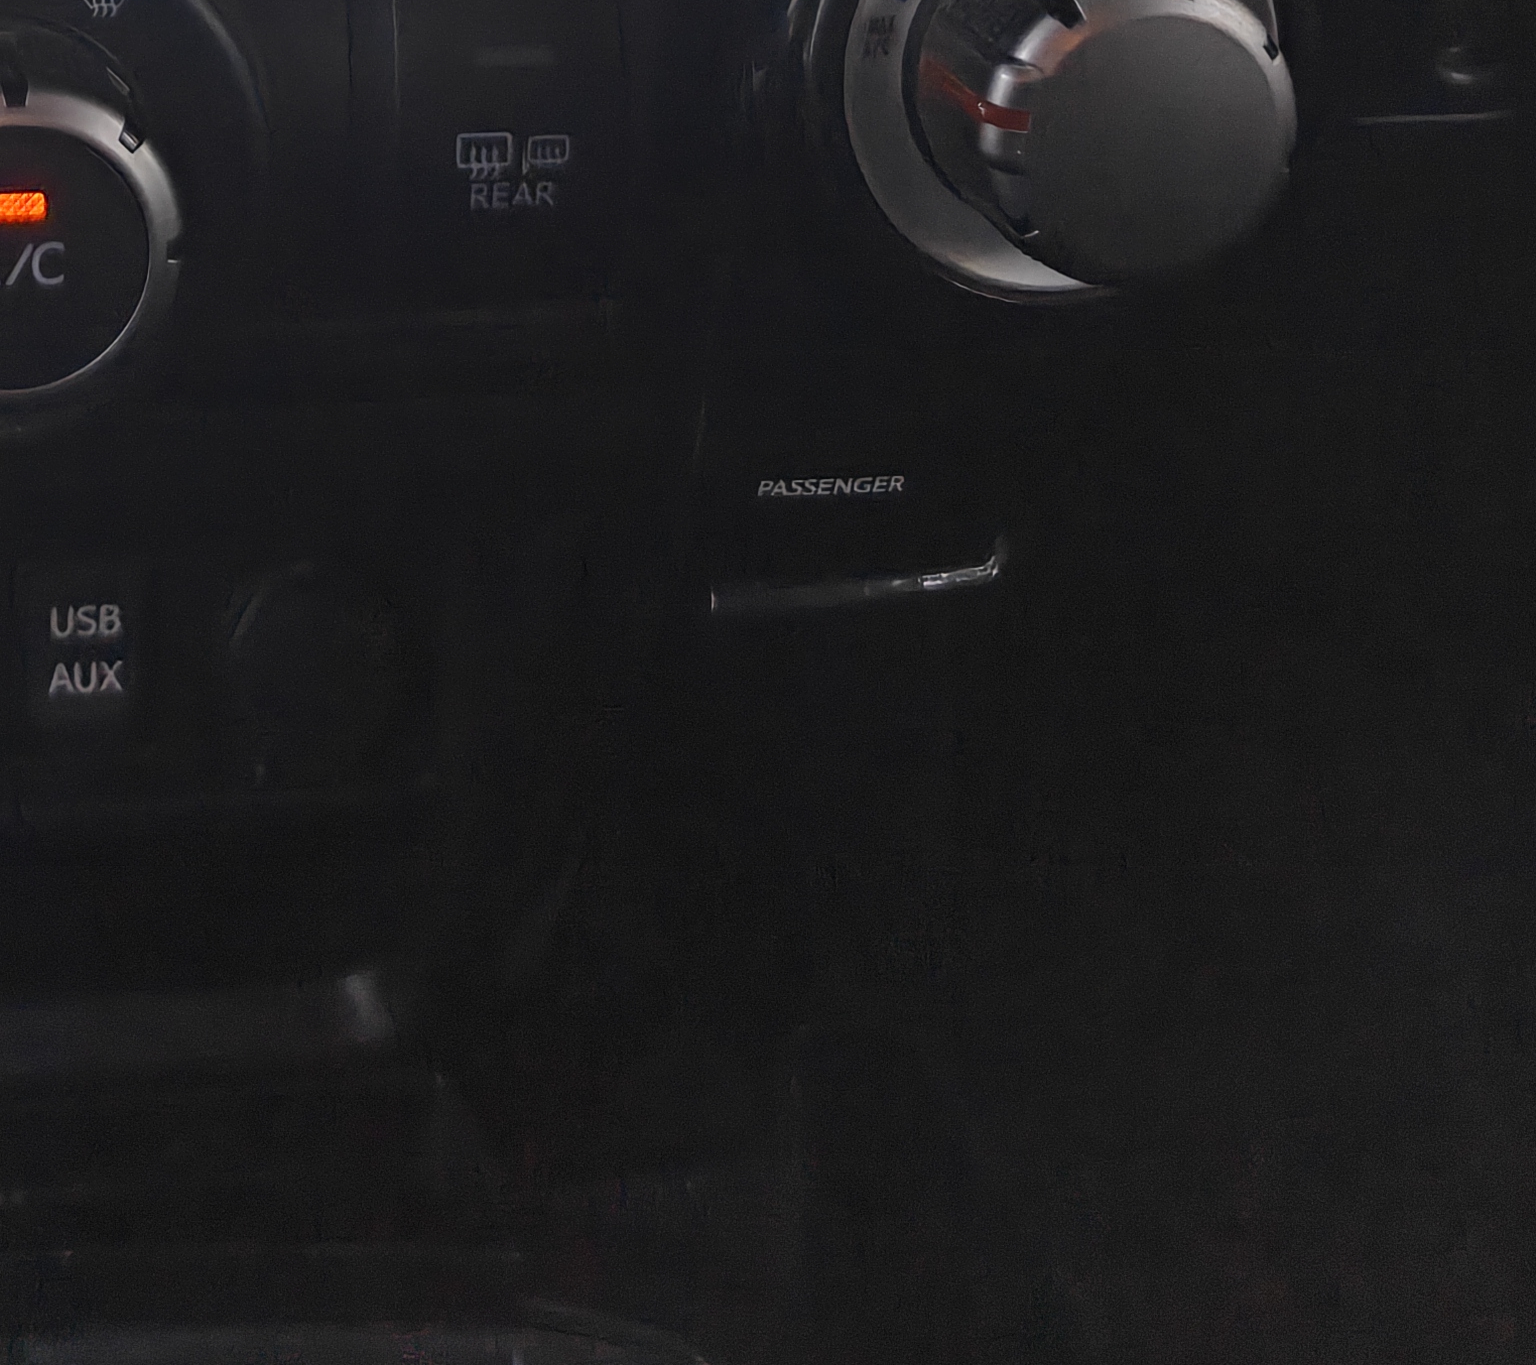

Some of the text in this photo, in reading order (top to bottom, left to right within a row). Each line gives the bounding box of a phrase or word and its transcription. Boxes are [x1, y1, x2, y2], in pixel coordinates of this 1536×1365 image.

[469, 182, 556, 209] REAR
[756, 474, 905, 498] PASSENGER
[49, 603, 124, 639] USB
[48, 659, 124, 697] AUX
